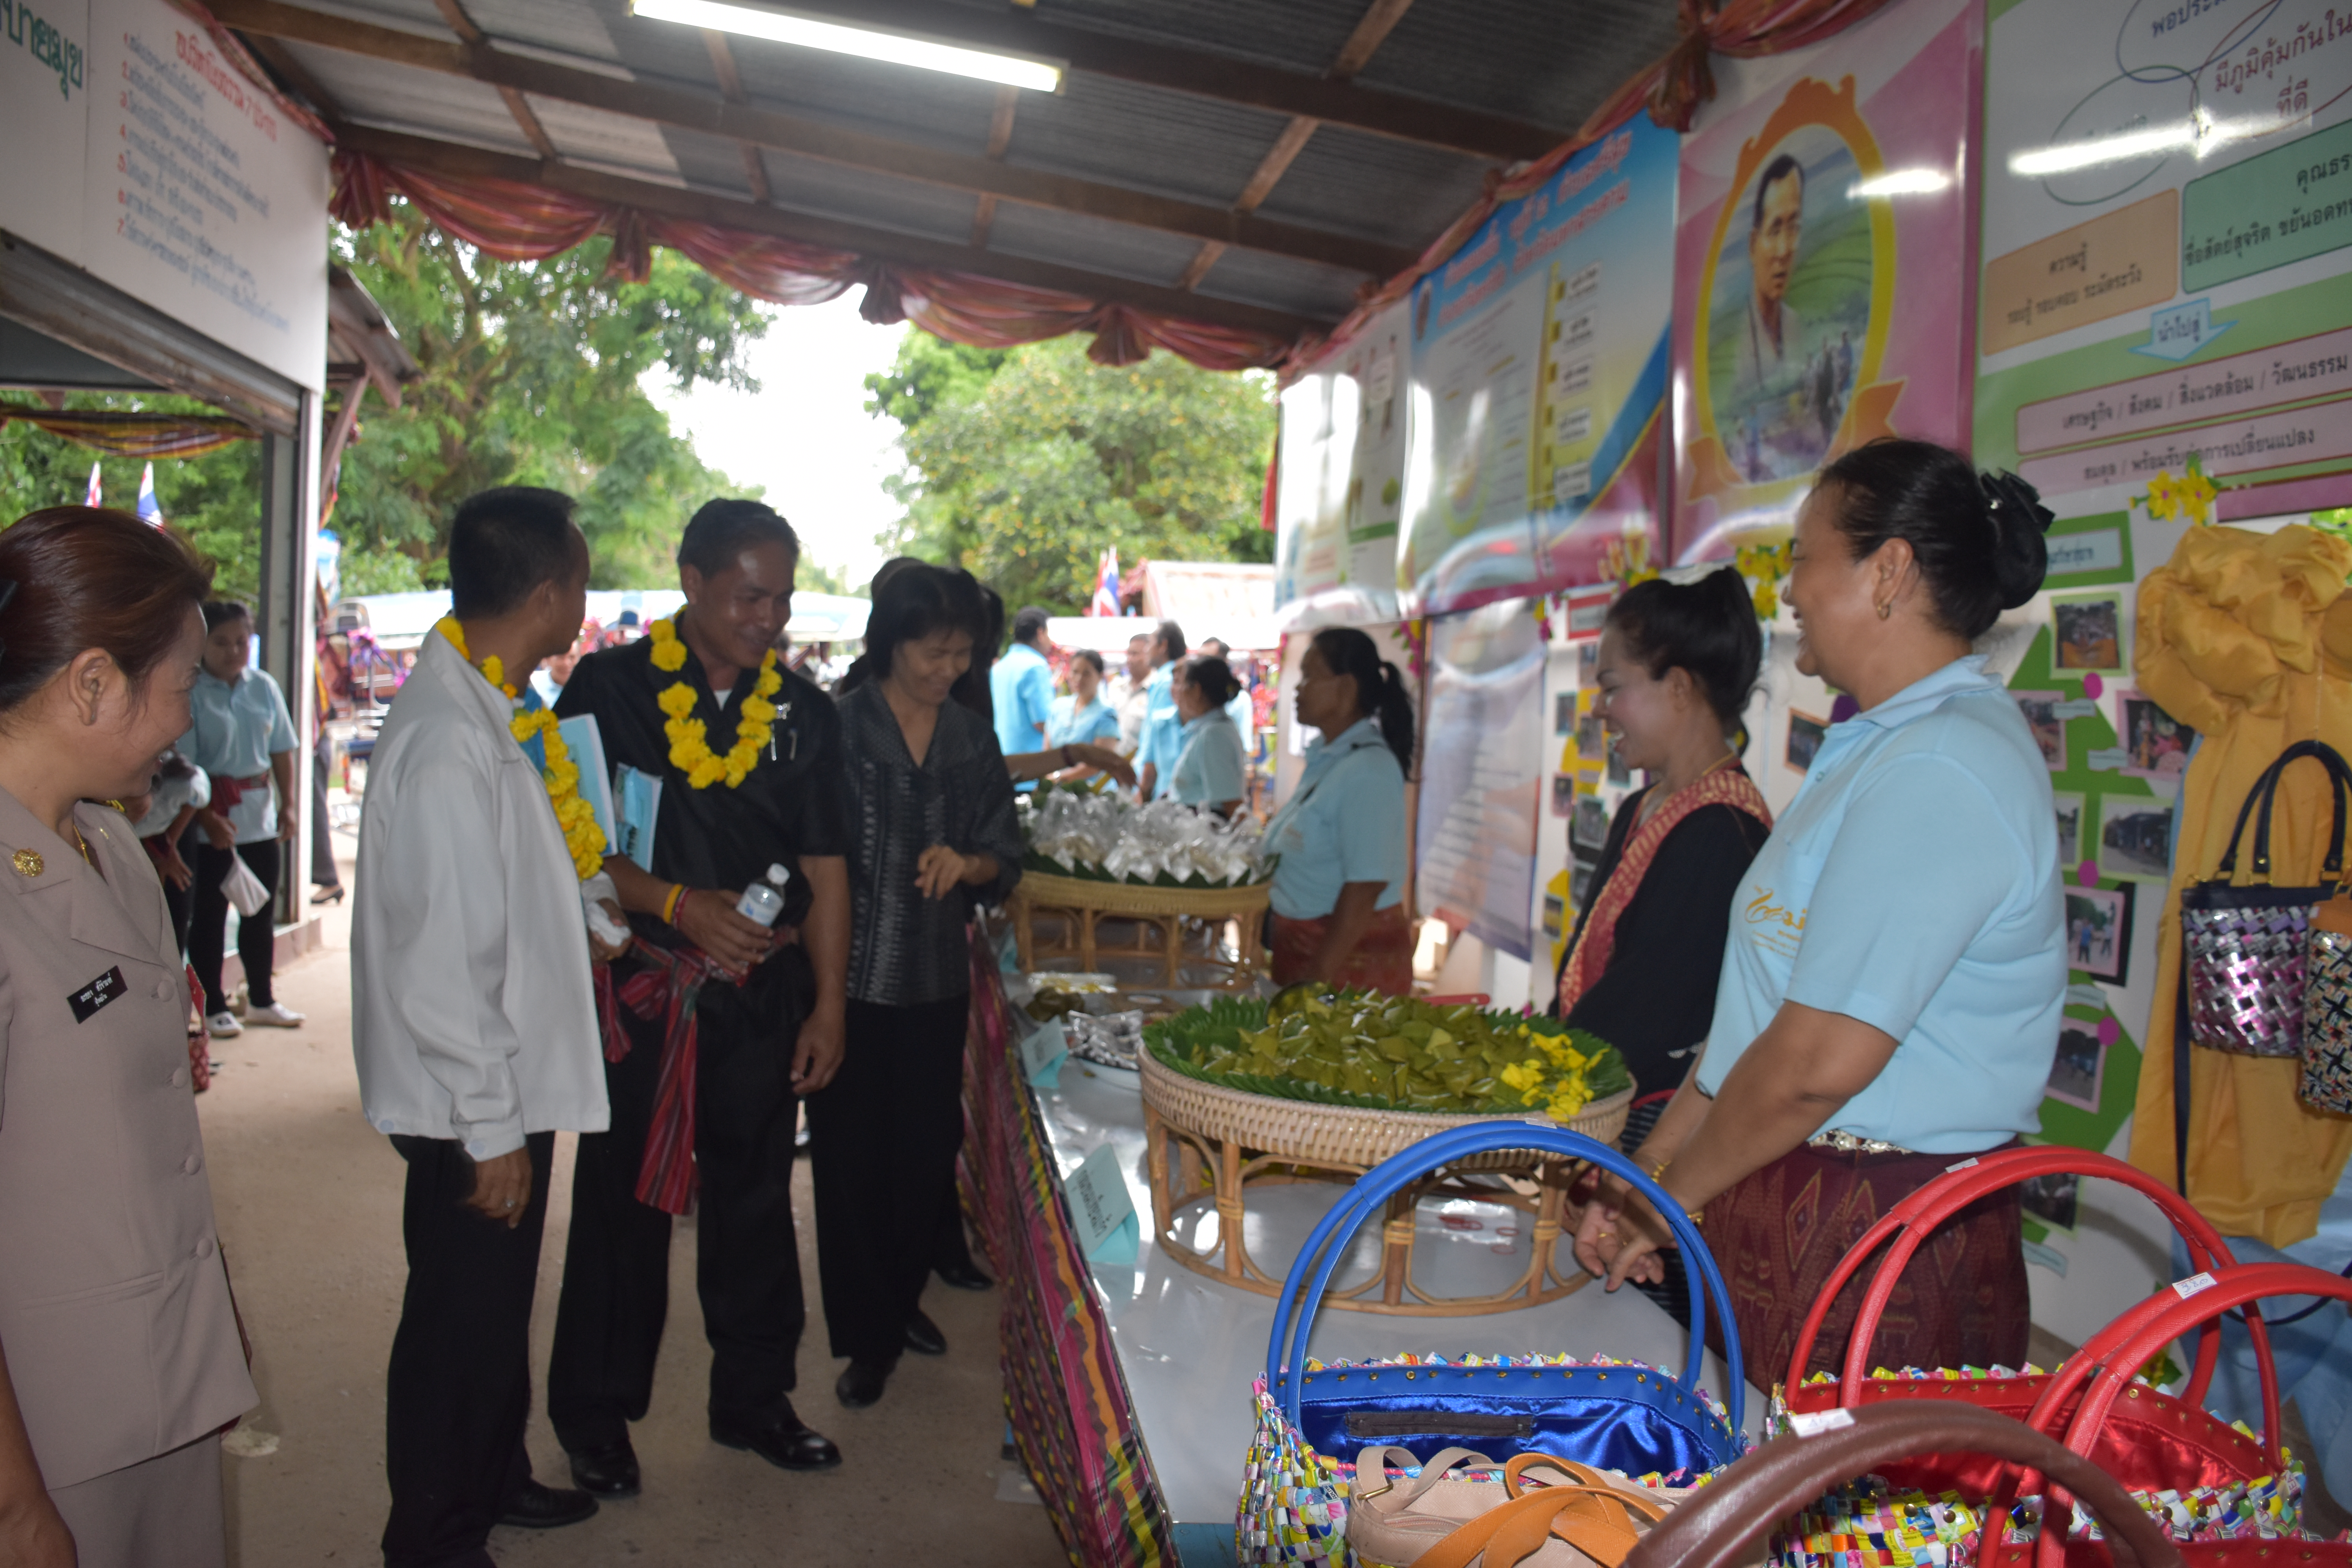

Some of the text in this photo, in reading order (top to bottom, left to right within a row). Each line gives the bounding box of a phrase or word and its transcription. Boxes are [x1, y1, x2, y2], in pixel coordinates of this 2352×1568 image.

[2152, 0, 2227, 38] พอประ
[0, 0, 83, 102] บายมุข
[2276, 74, 2308, 118] ที่ดี
[2272, 354, 2348, 387] วัฒนธรรม
